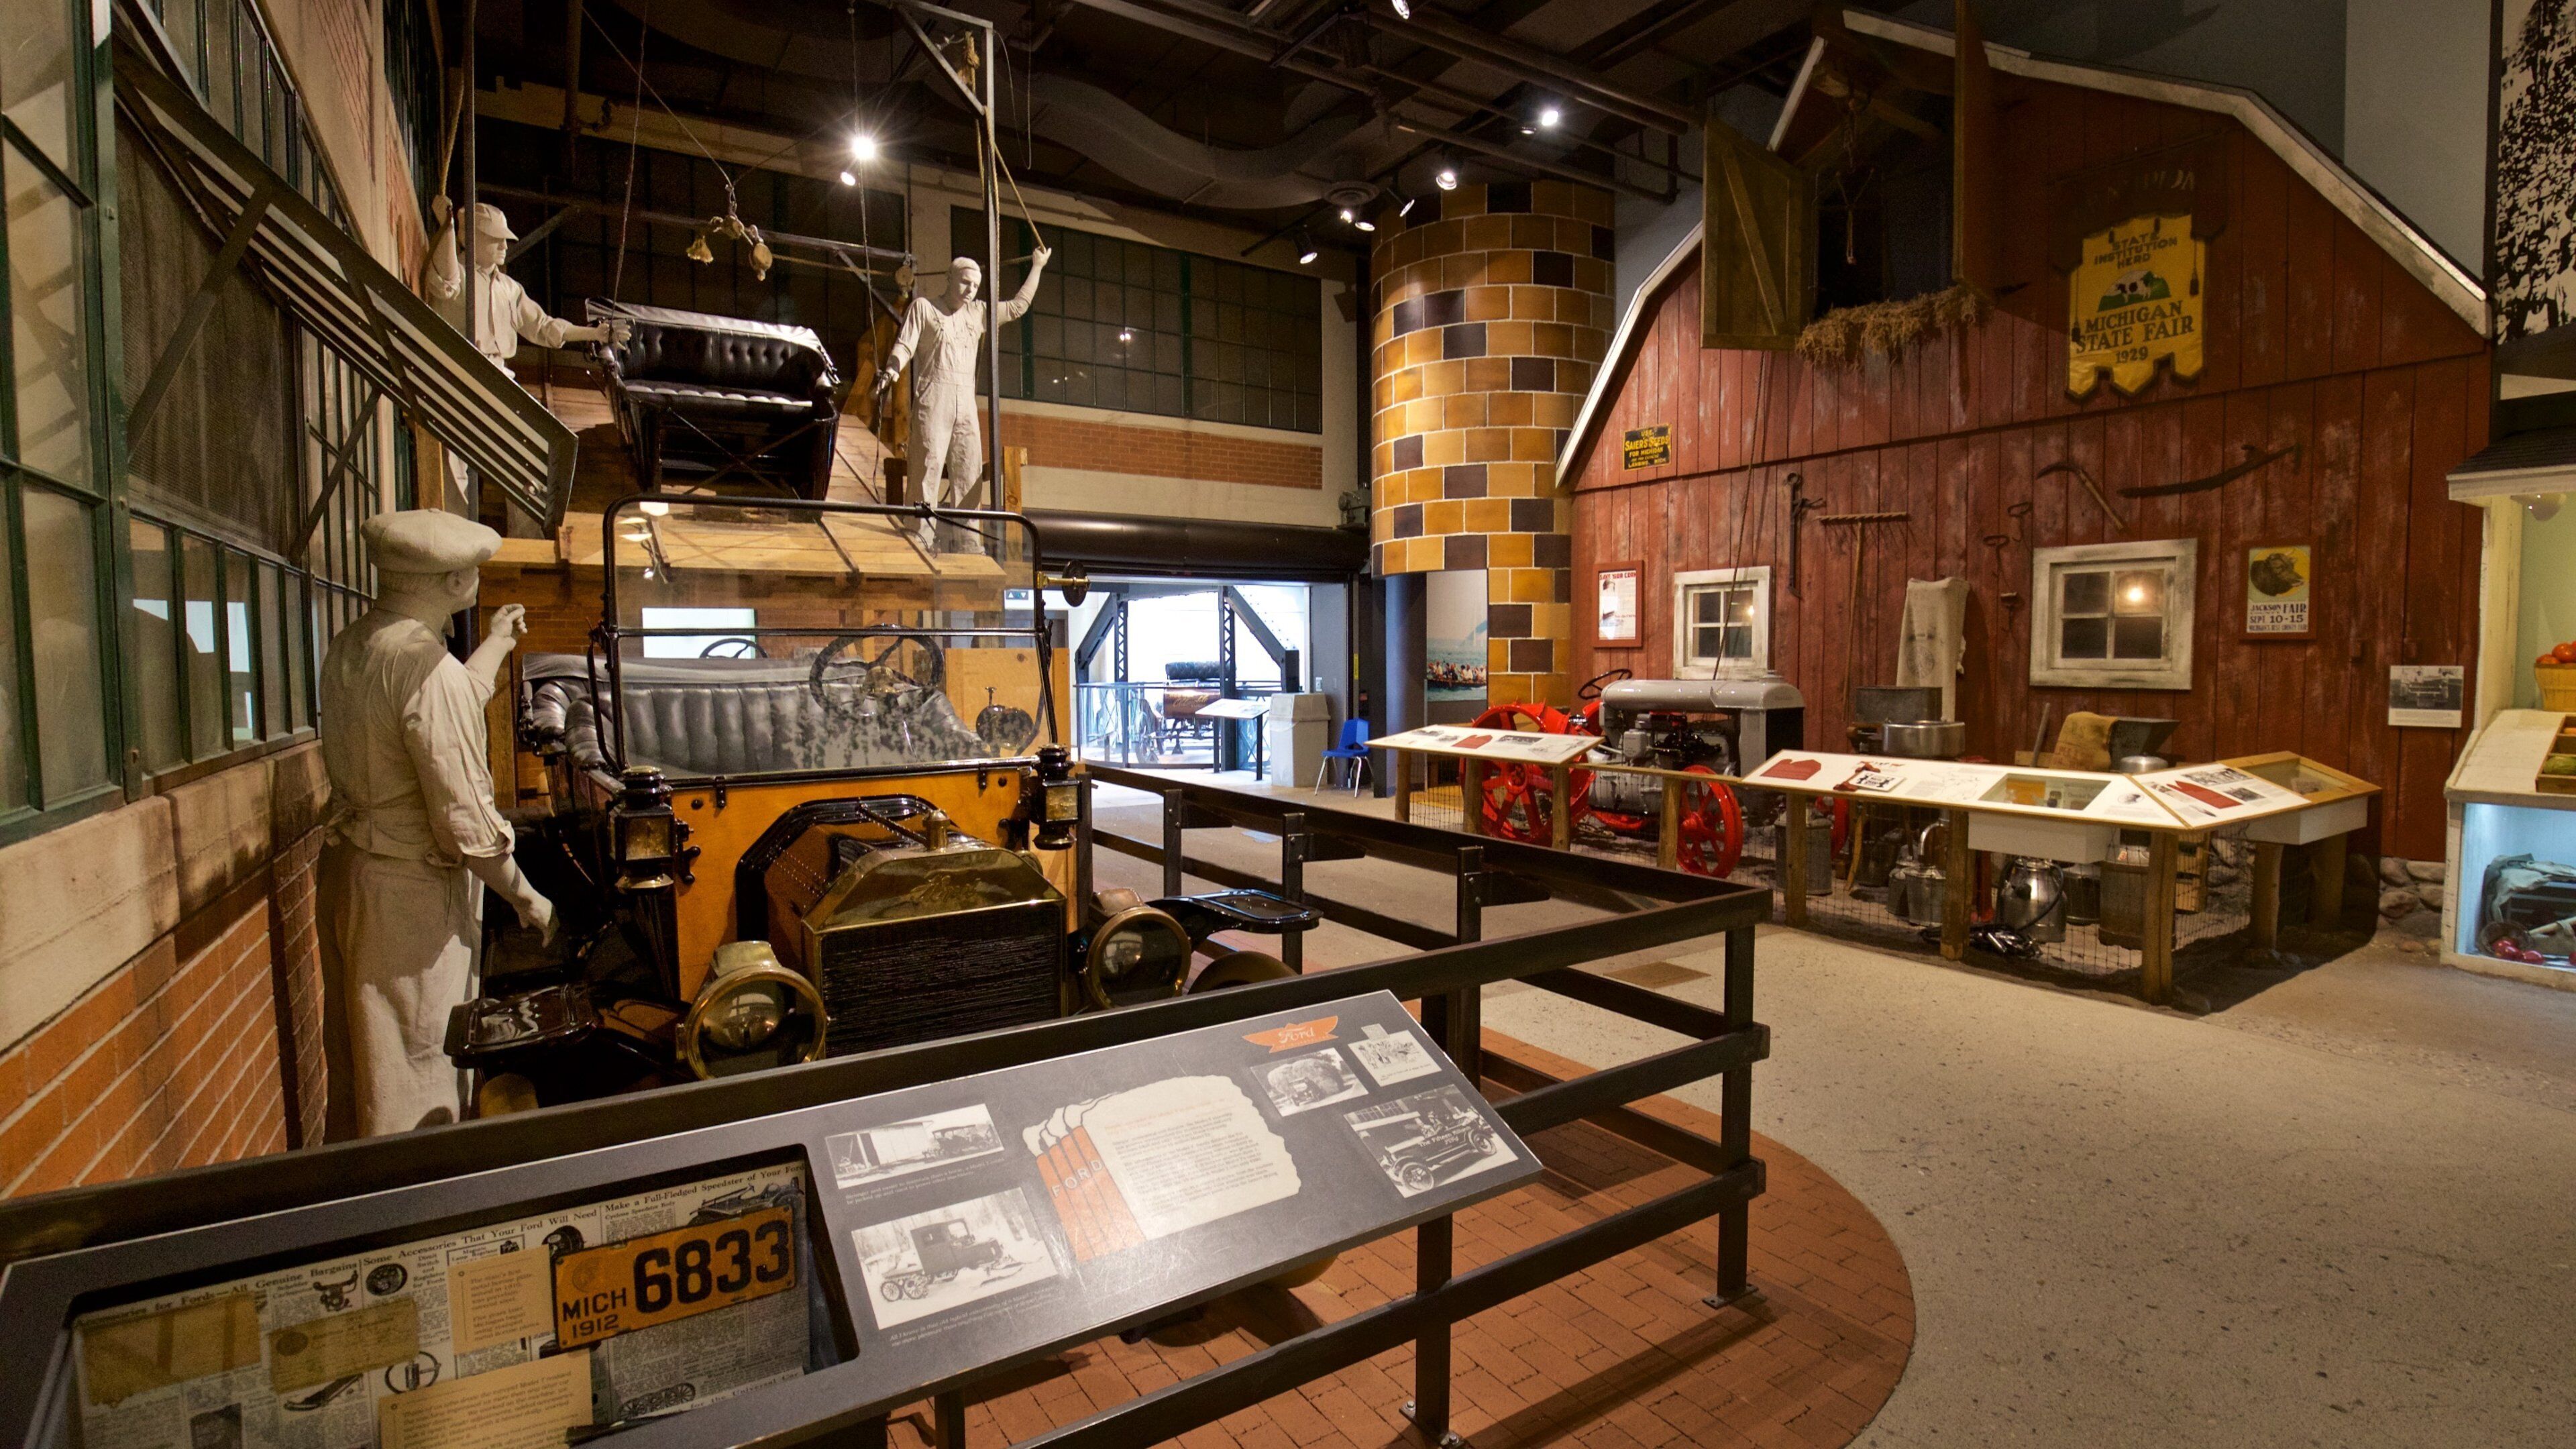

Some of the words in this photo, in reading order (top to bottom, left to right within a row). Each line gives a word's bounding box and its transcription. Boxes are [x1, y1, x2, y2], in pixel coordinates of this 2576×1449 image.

[2095, 238, 2178, 264] INSTITUTION
[2112, 233, 2160, 250] STATE
[2118, 254, 2151, 269] HERD
[2086, 300, 2184, 333] MICHIGAN
[2076, 327, 2133, 354] STATE
[2144, 315, 2194, 341] FAIR
[2116, 346, 2148, 364] 1929
[1649, 435, 1670, 447] SEEDS
[2283, 603, 2306, 613] FAIR
[1278, 1026, 1315, 1044] Ford
[605, 1201, 630, 1212] Make
[645, 1186, 698, 1204] Full-Fledged
[702, 1178, 743, 1193] Speedster
[747, 1173, 756, 1181] of
[760, 1169, 781, 1179] Your
[785, 1164, 804, 1175] Ford
[1051, 1159, 1102, 1197] FORD
[364, 1253, 392, 1265] Some
[398, 1240, 456, 1259] Accessories
[462, 1235, 485, 1244] That
[491, 1228, 515, 1238] Your
[521, 1221, 543, 1232] Ford
[549, 1215, 569, 1226] Will
[574, 1210, 597, 1221] Need
[256, 1273, 303, 1289] Genuine
[311, 1263, 358, 1278] Bargains
[562, 1288, 627, 1324] MICH
[633, 1220, 790, 1313] 6833
[572, 1313, 619, 1339] 1912
[711, 1395, 726, 1403] the
